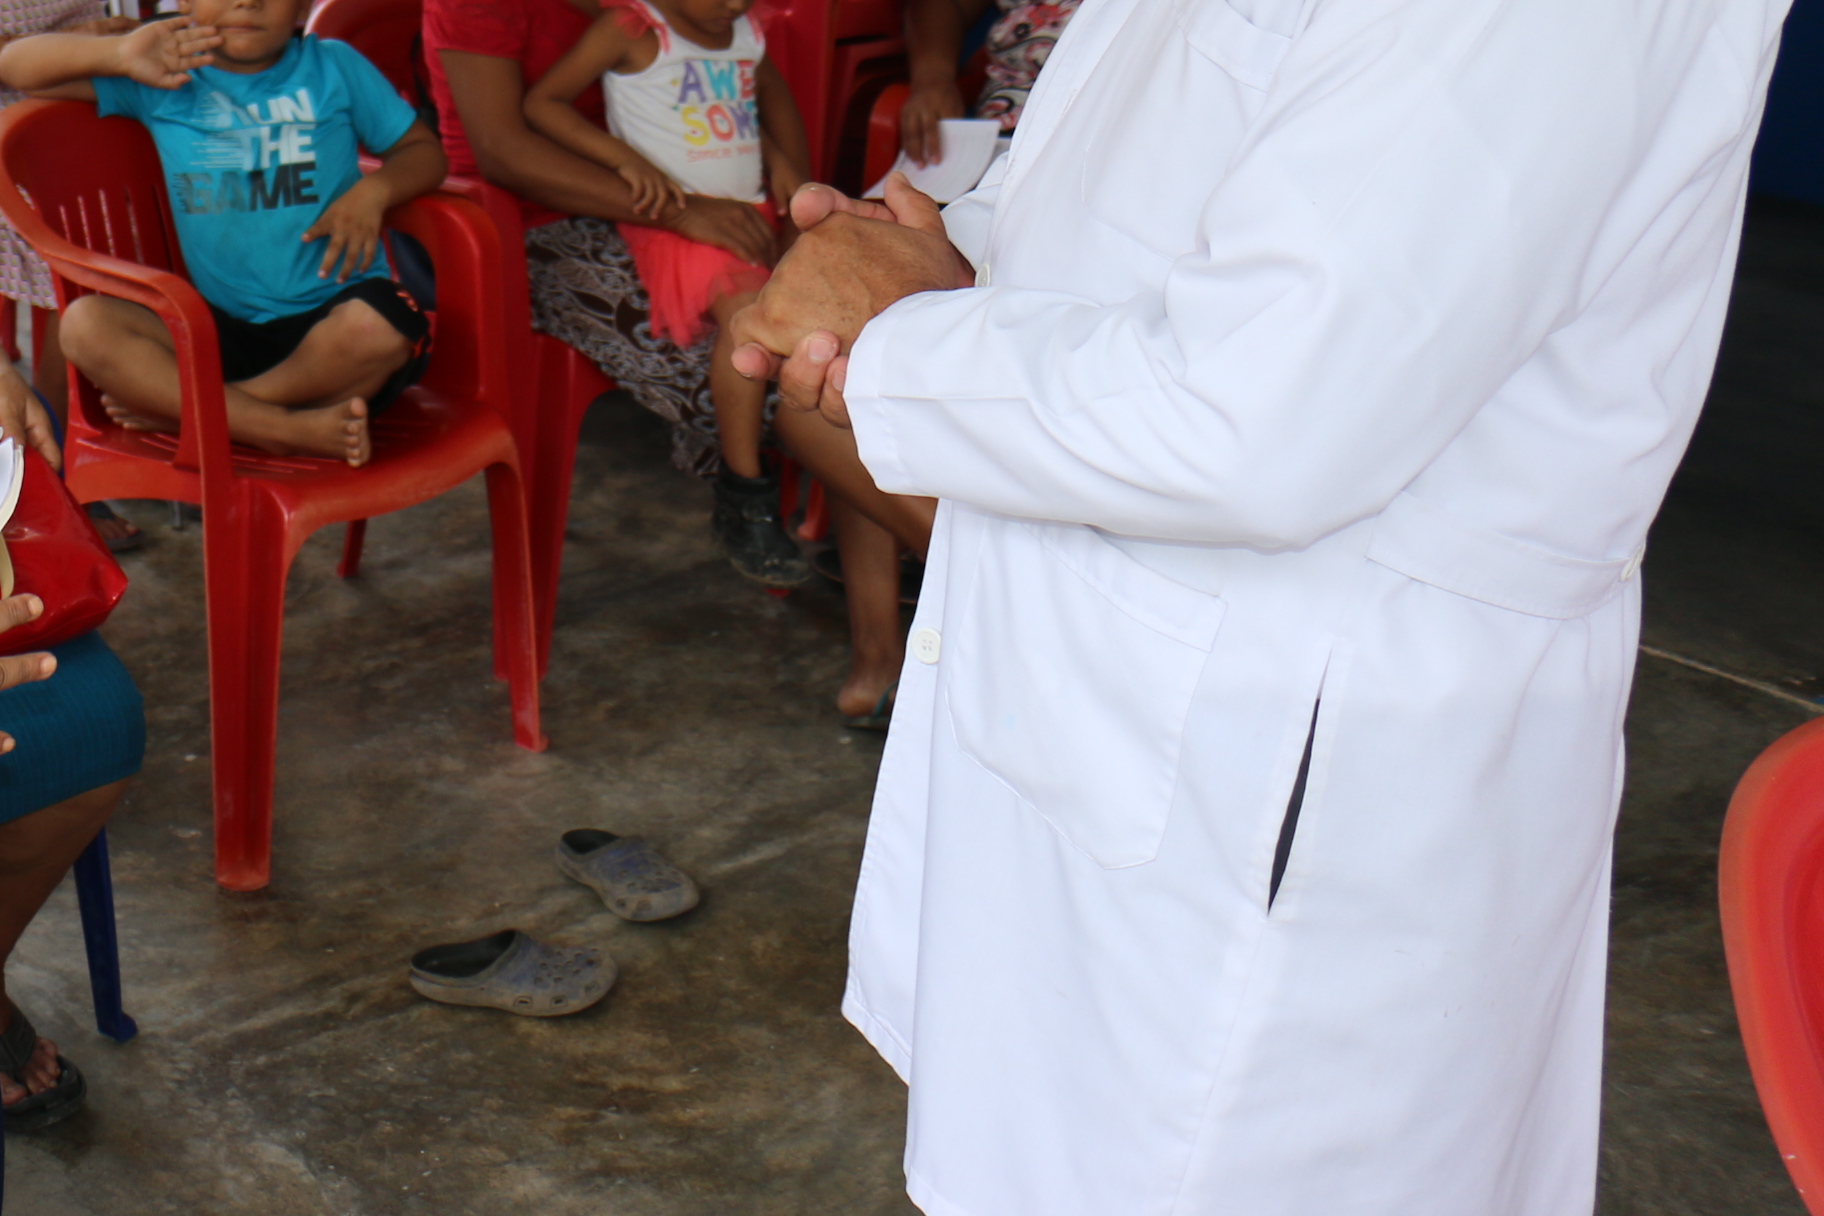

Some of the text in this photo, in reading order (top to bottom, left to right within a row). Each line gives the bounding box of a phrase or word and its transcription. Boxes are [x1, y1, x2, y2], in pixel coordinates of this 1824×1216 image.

[678, 59, 755, 105] AWE
[221, 123, 317, 171] THE
[174, 161, 319, 215] GAME
